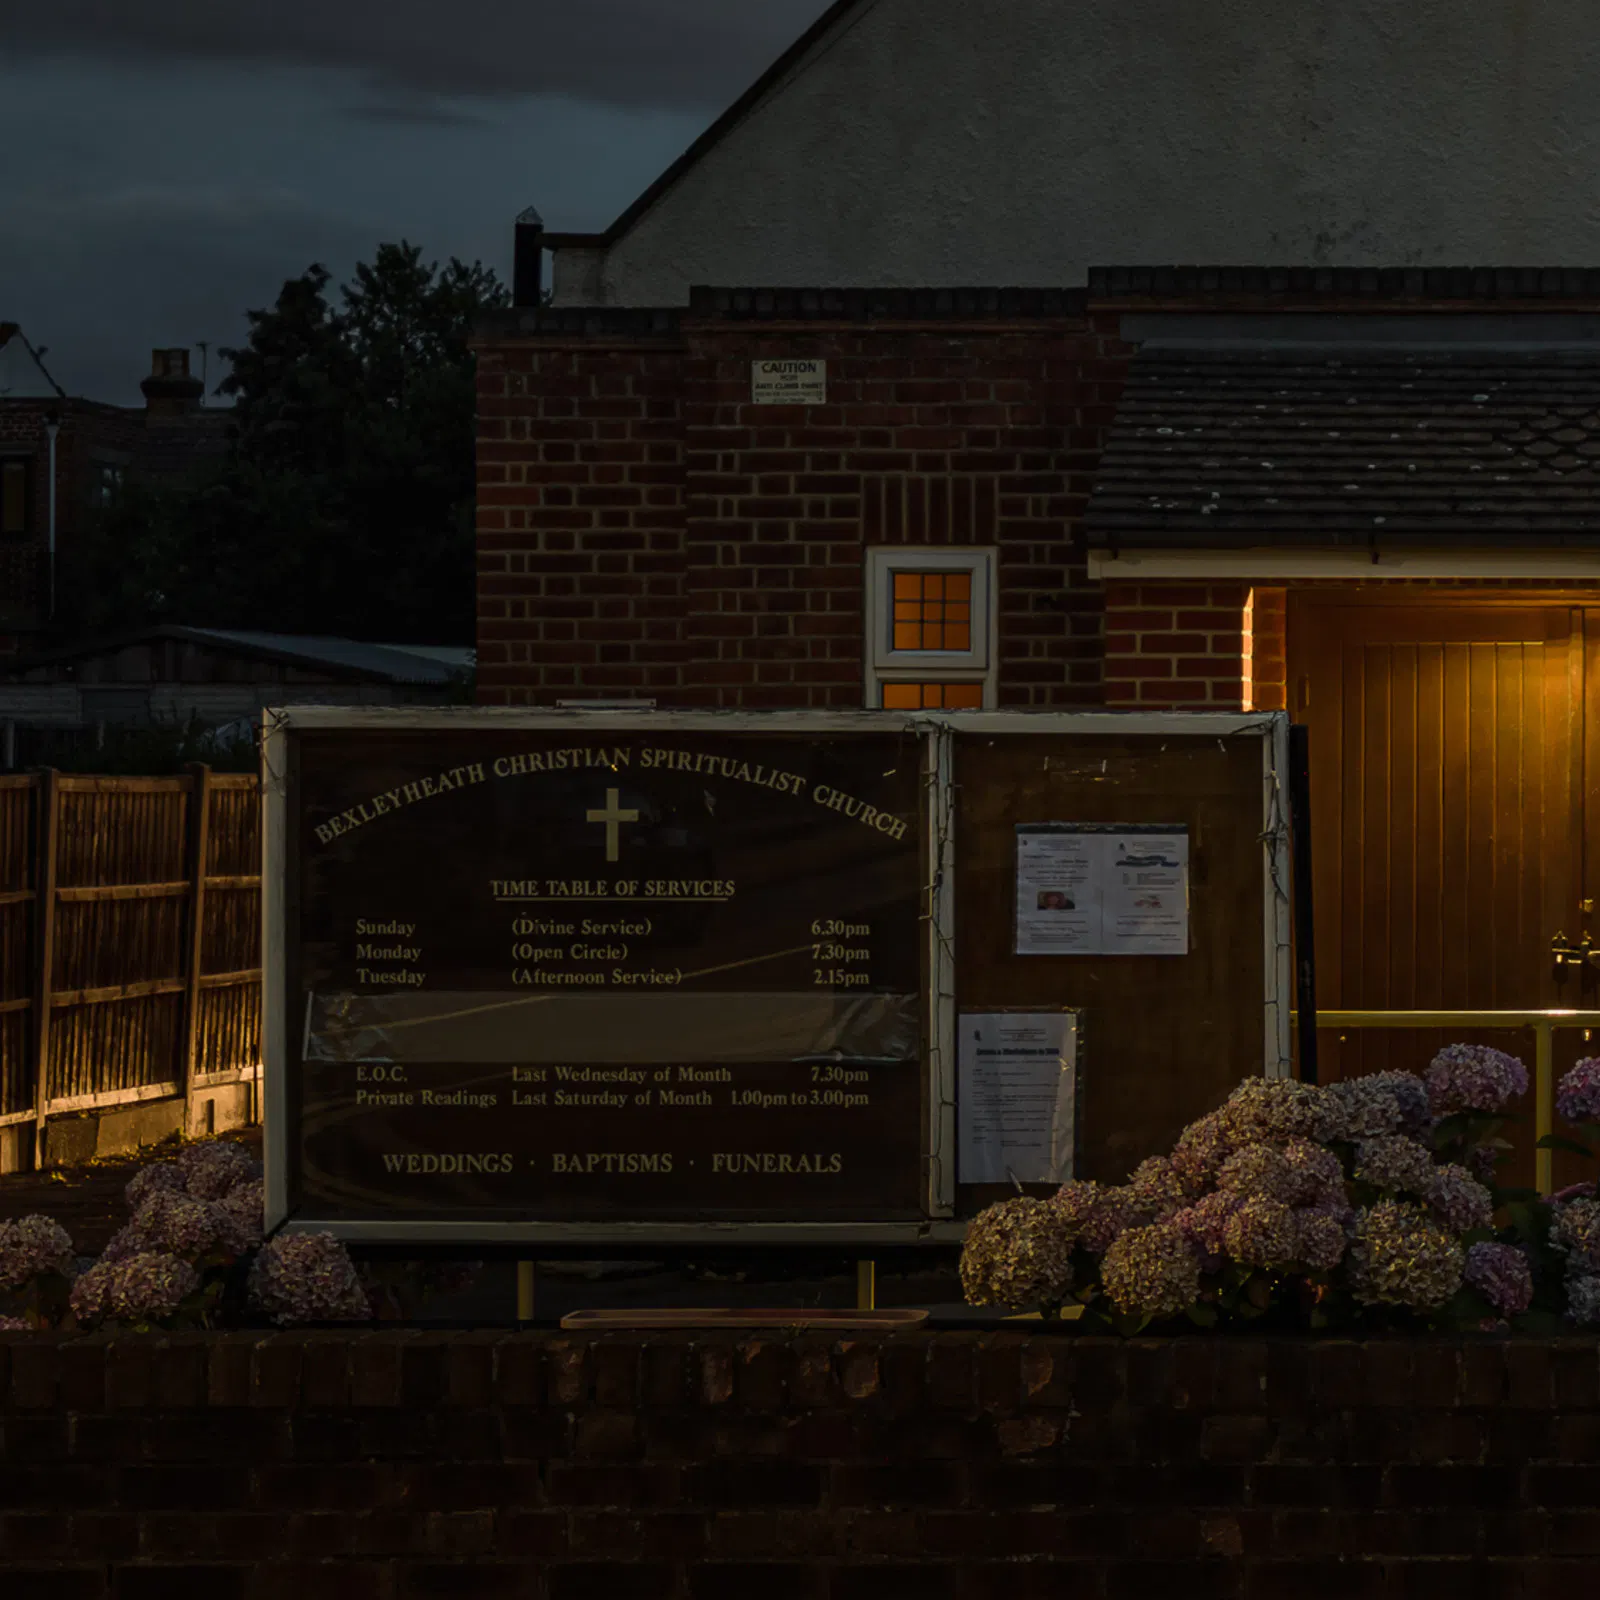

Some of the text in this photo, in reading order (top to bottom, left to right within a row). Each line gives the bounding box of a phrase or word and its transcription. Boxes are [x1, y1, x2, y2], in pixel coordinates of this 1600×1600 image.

[762, 362, 816, 373] CAUTION
[314, 747, 908, 845] BEXLEYHEATH CHRISTIAN SPIRITUALIST CHURCH
[490, 880, 736, 896] TIME TABLE OF SERVICES
[356, 918, 870, 938] Sunday (Divine Service) 6.30pm
[356, 943, 870, 963] Monday (Open Circle) 7.30pm
[356, 967, 870, 987] Tuesday (Afternoon Service) 2.15pm
[356, 1066, 870, 1085] E.O.C. Last Wednesday of Month 7.30pm
[356, 1089, 870, 1109] Private Readings Last Saturday of Month 1.00pm to 3.00pm
[382, 1153, 843, 1173] WEDDINGS BAPTISMS FUNERALS
